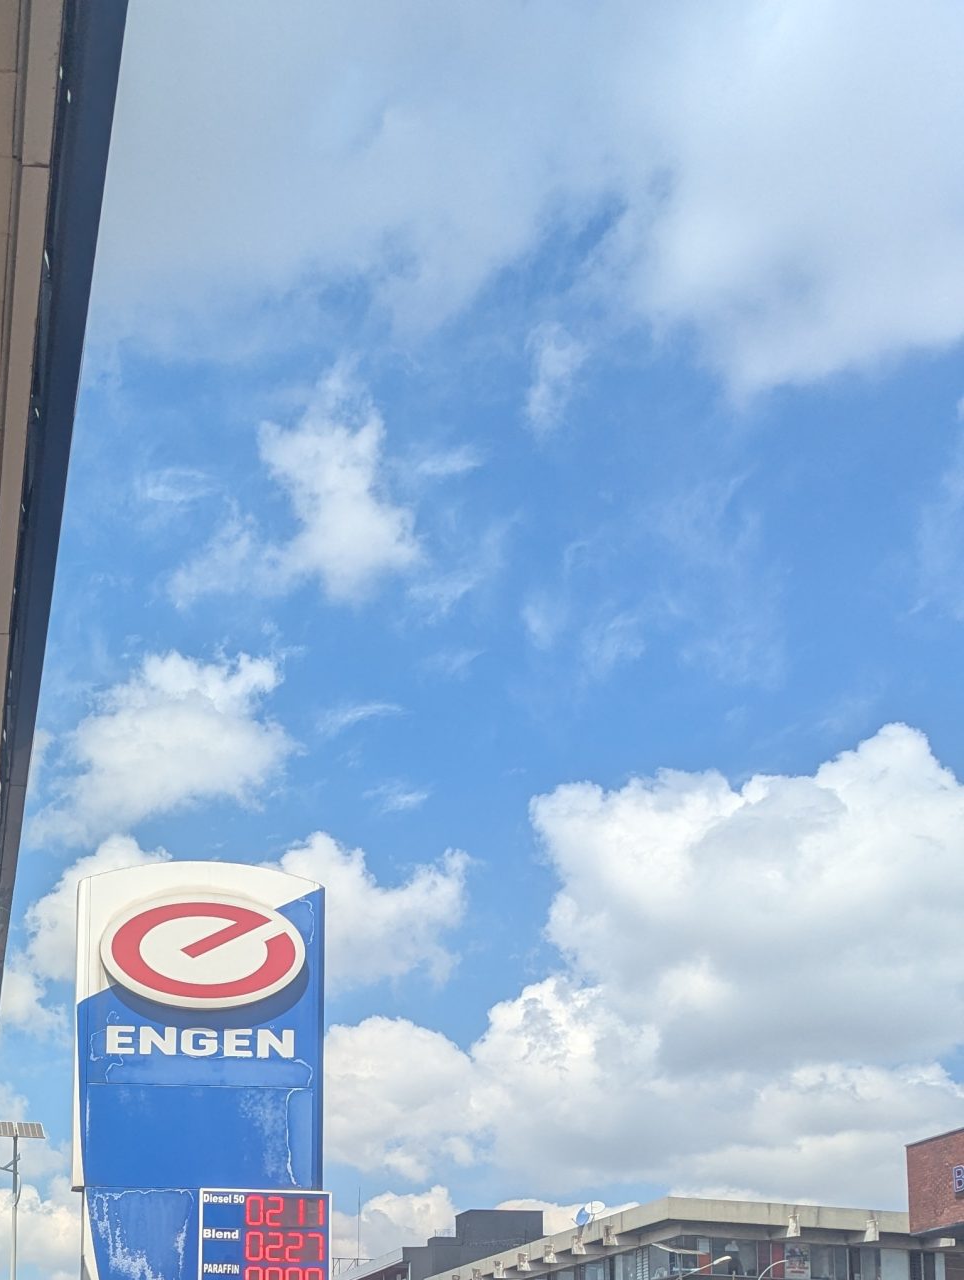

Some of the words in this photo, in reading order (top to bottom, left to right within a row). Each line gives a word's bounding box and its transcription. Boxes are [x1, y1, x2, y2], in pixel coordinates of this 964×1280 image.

[106, 1025, 295, 1059] ENGEN
[203, 1193, 232, 1204] Diesel
[234, 1195, 245, 1204] 50
[246, 1195, 324, 1226] 0211
[203, 1228, 239, 1239] Blend
[245, 1231, 324, 1262] 0227
[203, 1263, 240, 1274] PARAFFIN
